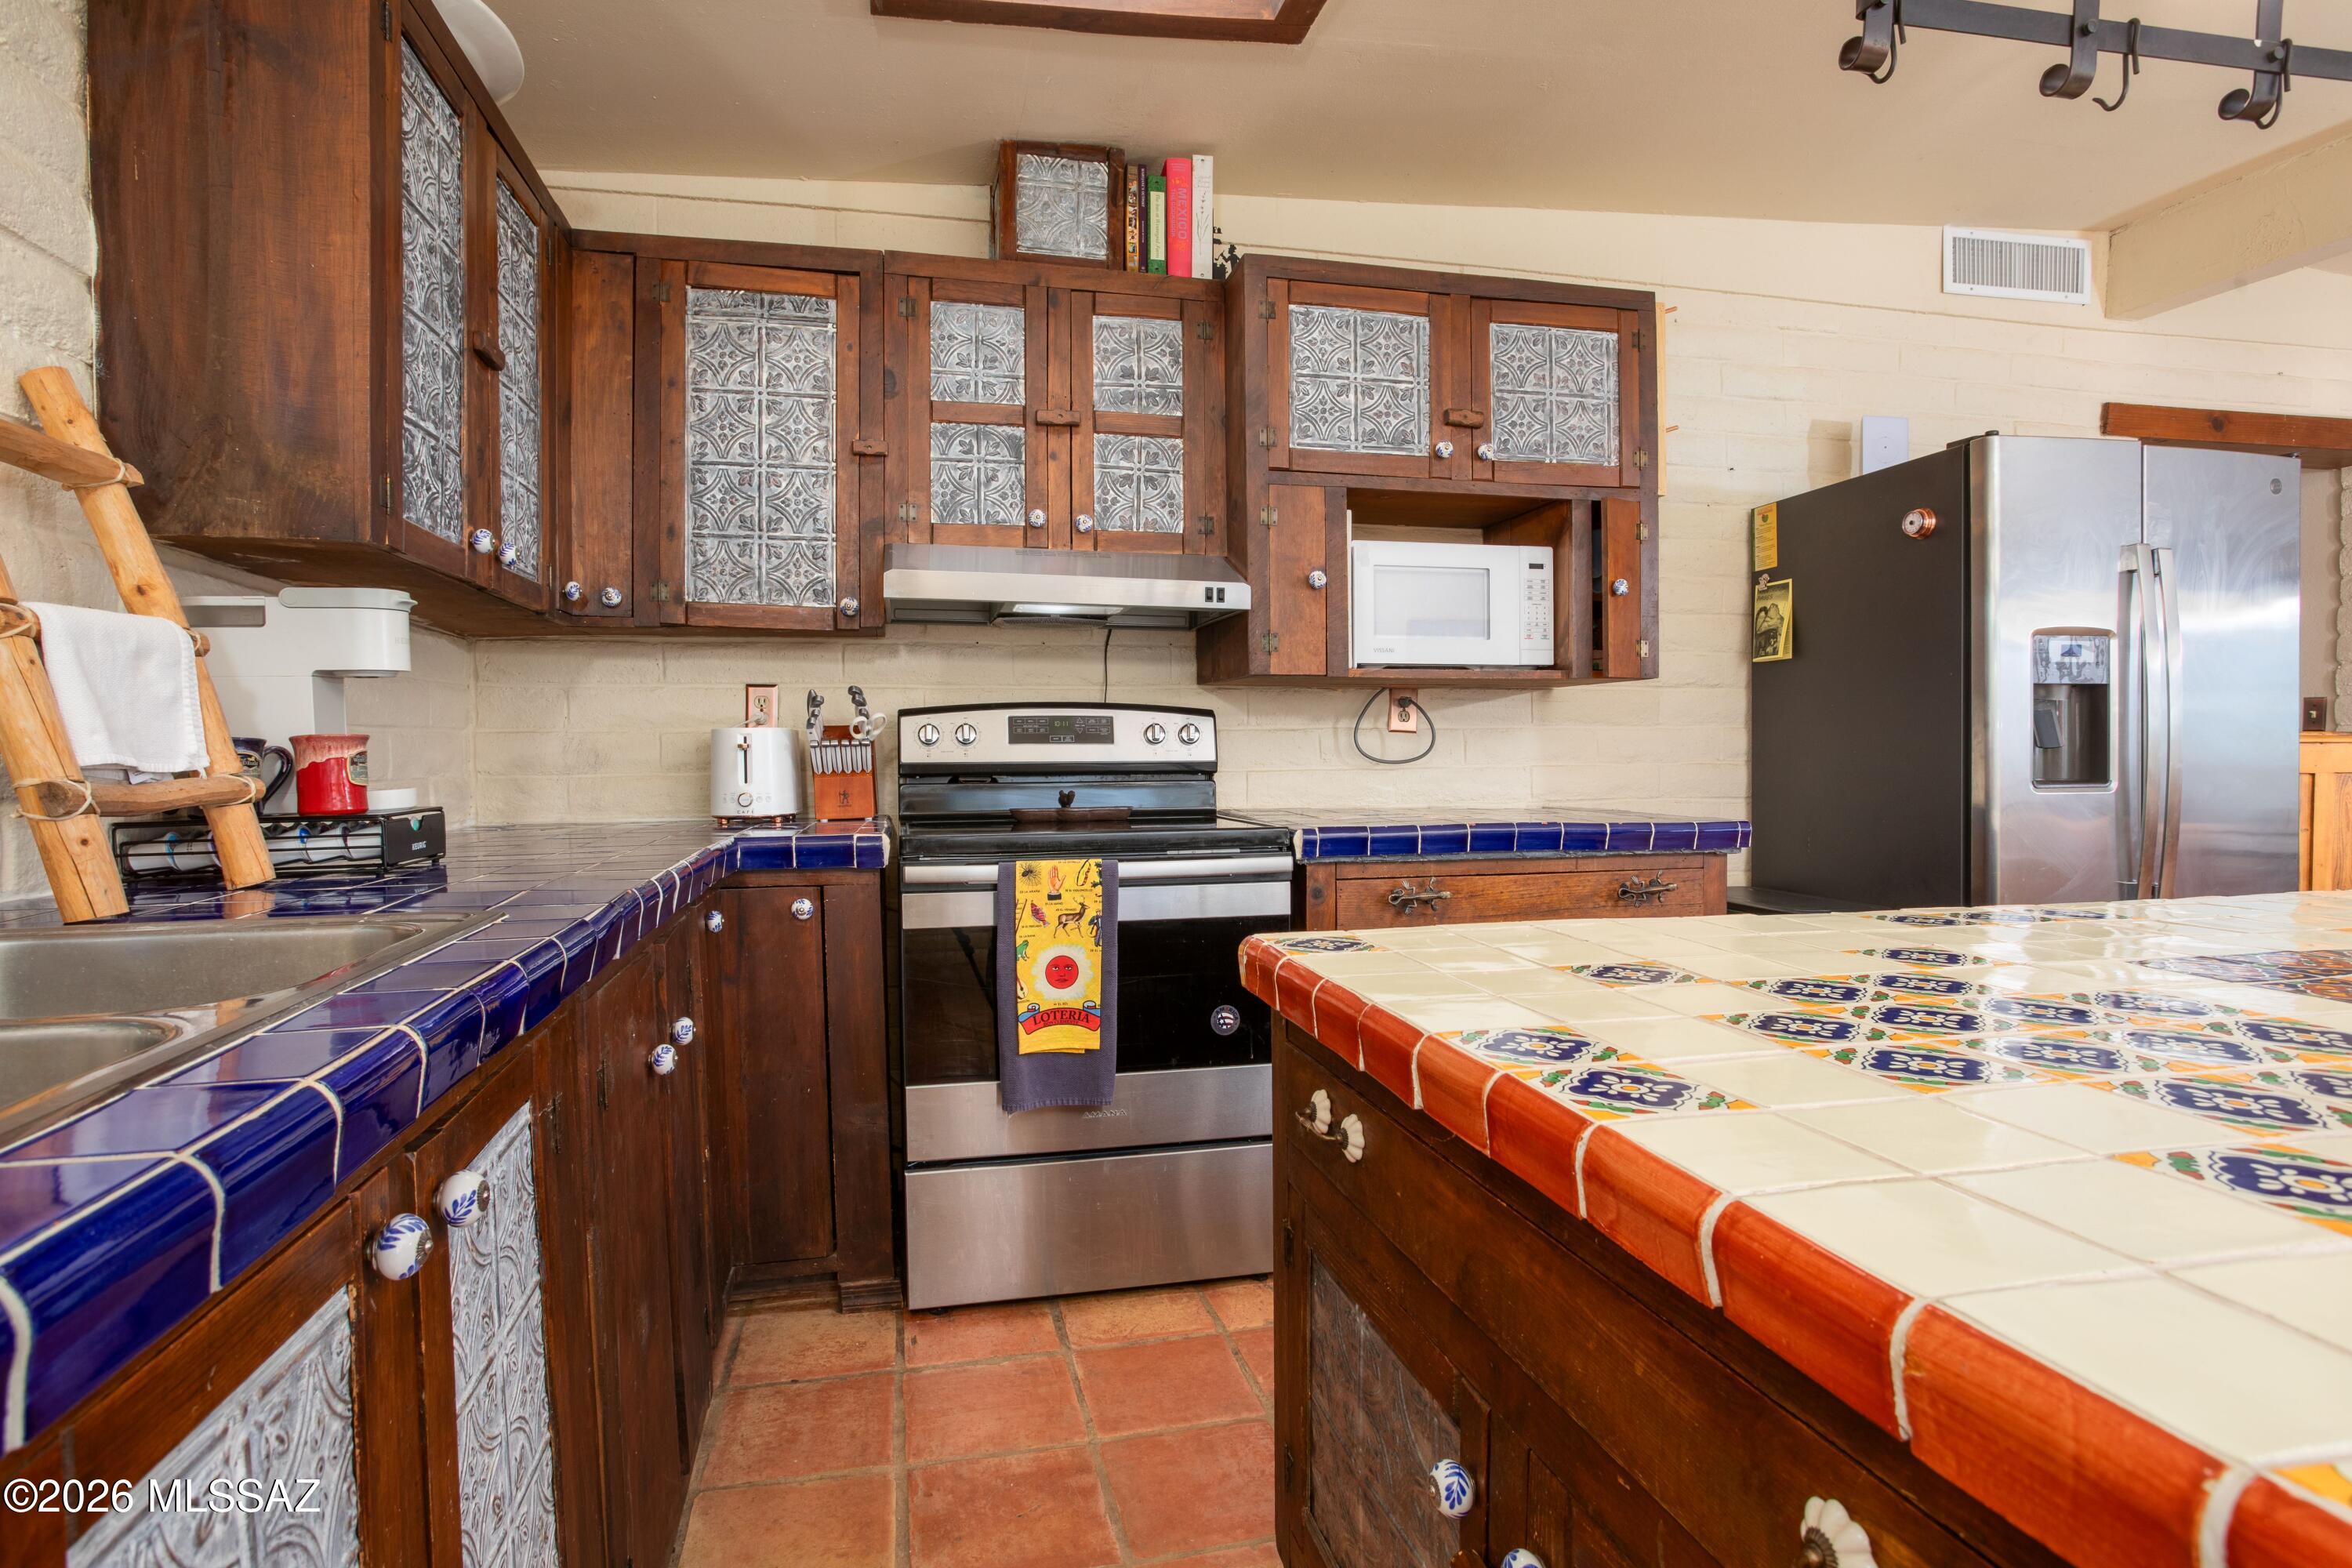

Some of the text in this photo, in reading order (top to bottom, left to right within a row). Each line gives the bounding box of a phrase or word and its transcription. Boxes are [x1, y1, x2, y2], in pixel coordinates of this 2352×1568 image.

[1178, 187, 1188, 239] MEXICO
[1033, 1010, 1090, 1025] LOTERIA
[1083, 1109, 1129, 1118] AMANA
